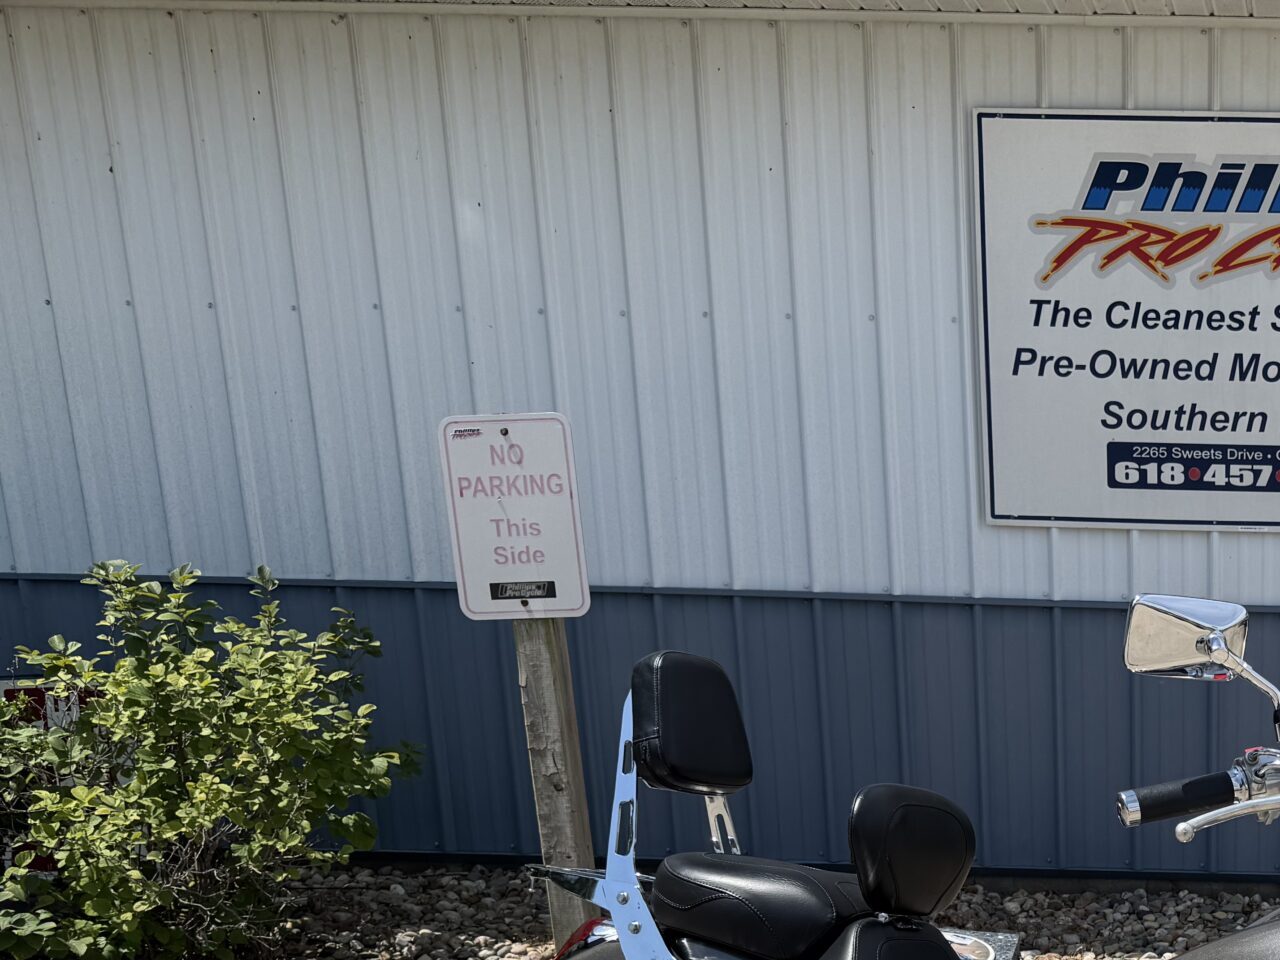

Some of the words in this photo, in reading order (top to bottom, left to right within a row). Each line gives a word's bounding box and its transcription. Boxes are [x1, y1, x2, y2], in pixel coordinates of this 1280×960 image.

[1035, 216, 1223, 283] PRO
[1029, 299, 1092, 329] The
[1105, 300, 1259, 333] Cleanest
[1012, 347, 1219, 383] Pre-Owned
[1101, 401, 1268, 434] Southern
[490, 443, 525, 466] NO
[1132, 446, 1168, 459] 2265
[1171, 447, 1223, 460] Sweets
[1226, 448, 1264, 461] Drive
[457, 473, 564, 498] PARKING
[489, 518, 542, 538] This
[494, 545, 545, 565] Side
